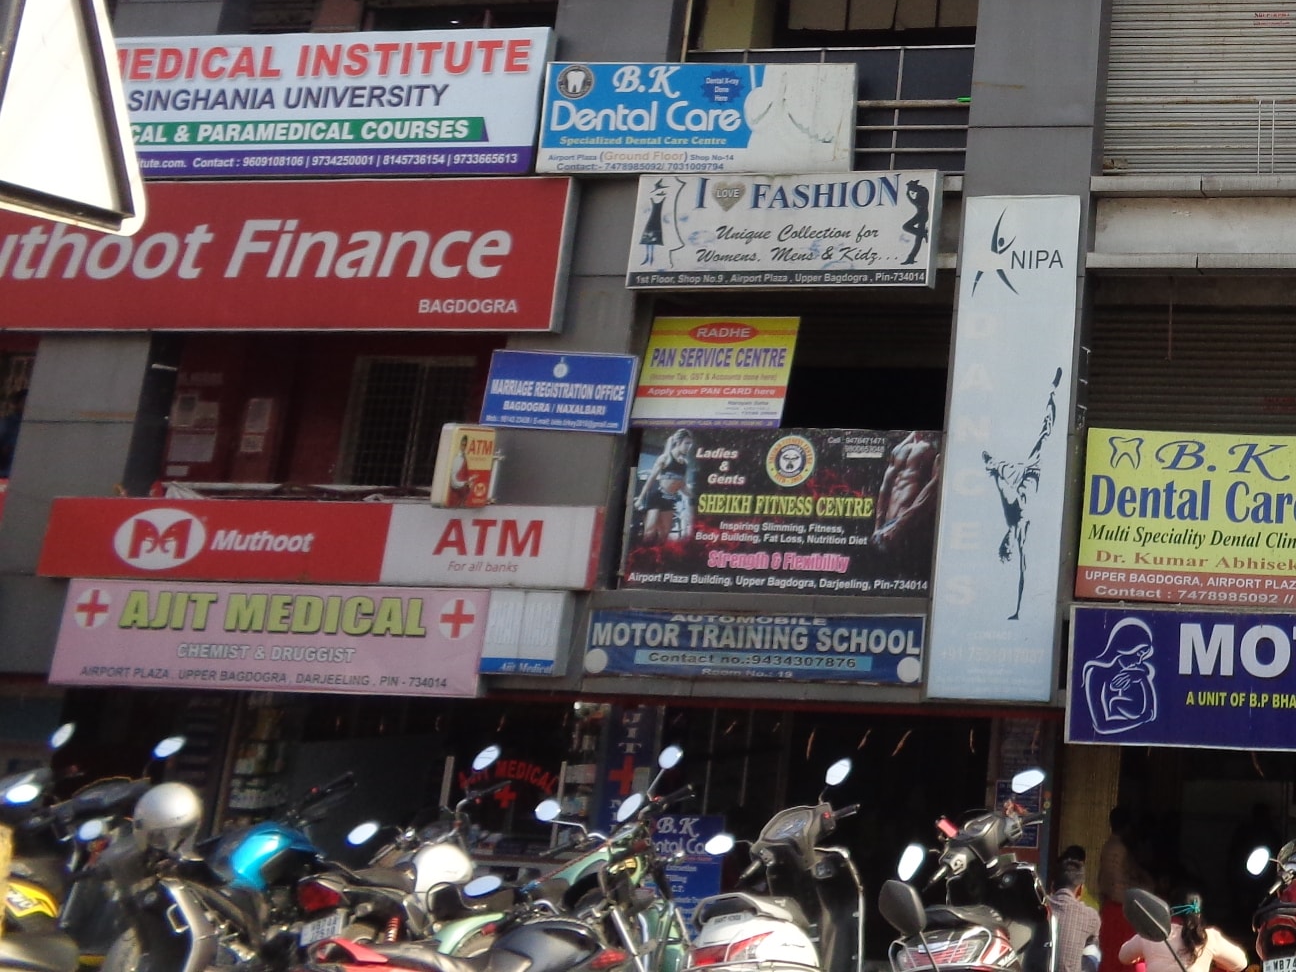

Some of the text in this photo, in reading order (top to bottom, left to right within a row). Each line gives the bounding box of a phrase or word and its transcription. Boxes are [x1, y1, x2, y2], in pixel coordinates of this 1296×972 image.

[296, 39, 532, 78] INSTITUTE
[128, 84, 449, 111] SINGHANIA UNIVERSITY
[551, 100, 741, 132] Dental Care
[197, 120, 469, 142] PARAMEDICAL COURSES
[560, 136, 622, 145] Specialized
[193, 158, 234, 167] Contact
[751, 174, 900, 208] FASHION
[778, 225, 850, 242] Collection
[224, 219, 512, 279] Finance
[770, 247, 813, 262] Mens
[1011, 249, 1063, 270] NIPA
[731, 274, 762, 284] Airport
[418, 298, 517, 314] BAGDOGRA
[696, 328, 751, 338] RADHE
[679, 348, 787, 368] SERVICE CENTRE
[491, 379, 533, 396] MARRIAGE
[503, 401, 550, 413] BAGDOGRA
[467, 440, 493, 456] ATM
[696, 448, 738, 459] Ladies
[719, 462, 729, 471] &
[708, 473, 746, 486] Gents
[698, 494, 874, 517] SHEIKH FITNESS CENTRE
[1089, 474, 1211, 521] Dental
[720, 521, 759, 533] Inspiring
[211, 518, 544, 558] Muthoot ATM
[807, 534, 846, 545] Nutrition
[1132, 527, 1261, 550] Speciality Dental
[485, 561, 519, 573] banks
[708, 550, 769, 570] Strength
[874, 579, 928, 590] Pin-734014
[1207, 576, 1261, 590] AIRPORT
[1095, 585, 1162, 599] Contact
[118, 590, 426, 637] AJIT MEDICAL
[670, 613, 827, 626] AUTOMOBILE
[592, 622, 920, 655] MOTOR TRAINING SCHOOL
[177, 643, 356, 663] CHEMIST DRUGGIST
[648, 651, 715, 665] Contact
[80, 666, 131, 678] AIRPORT
